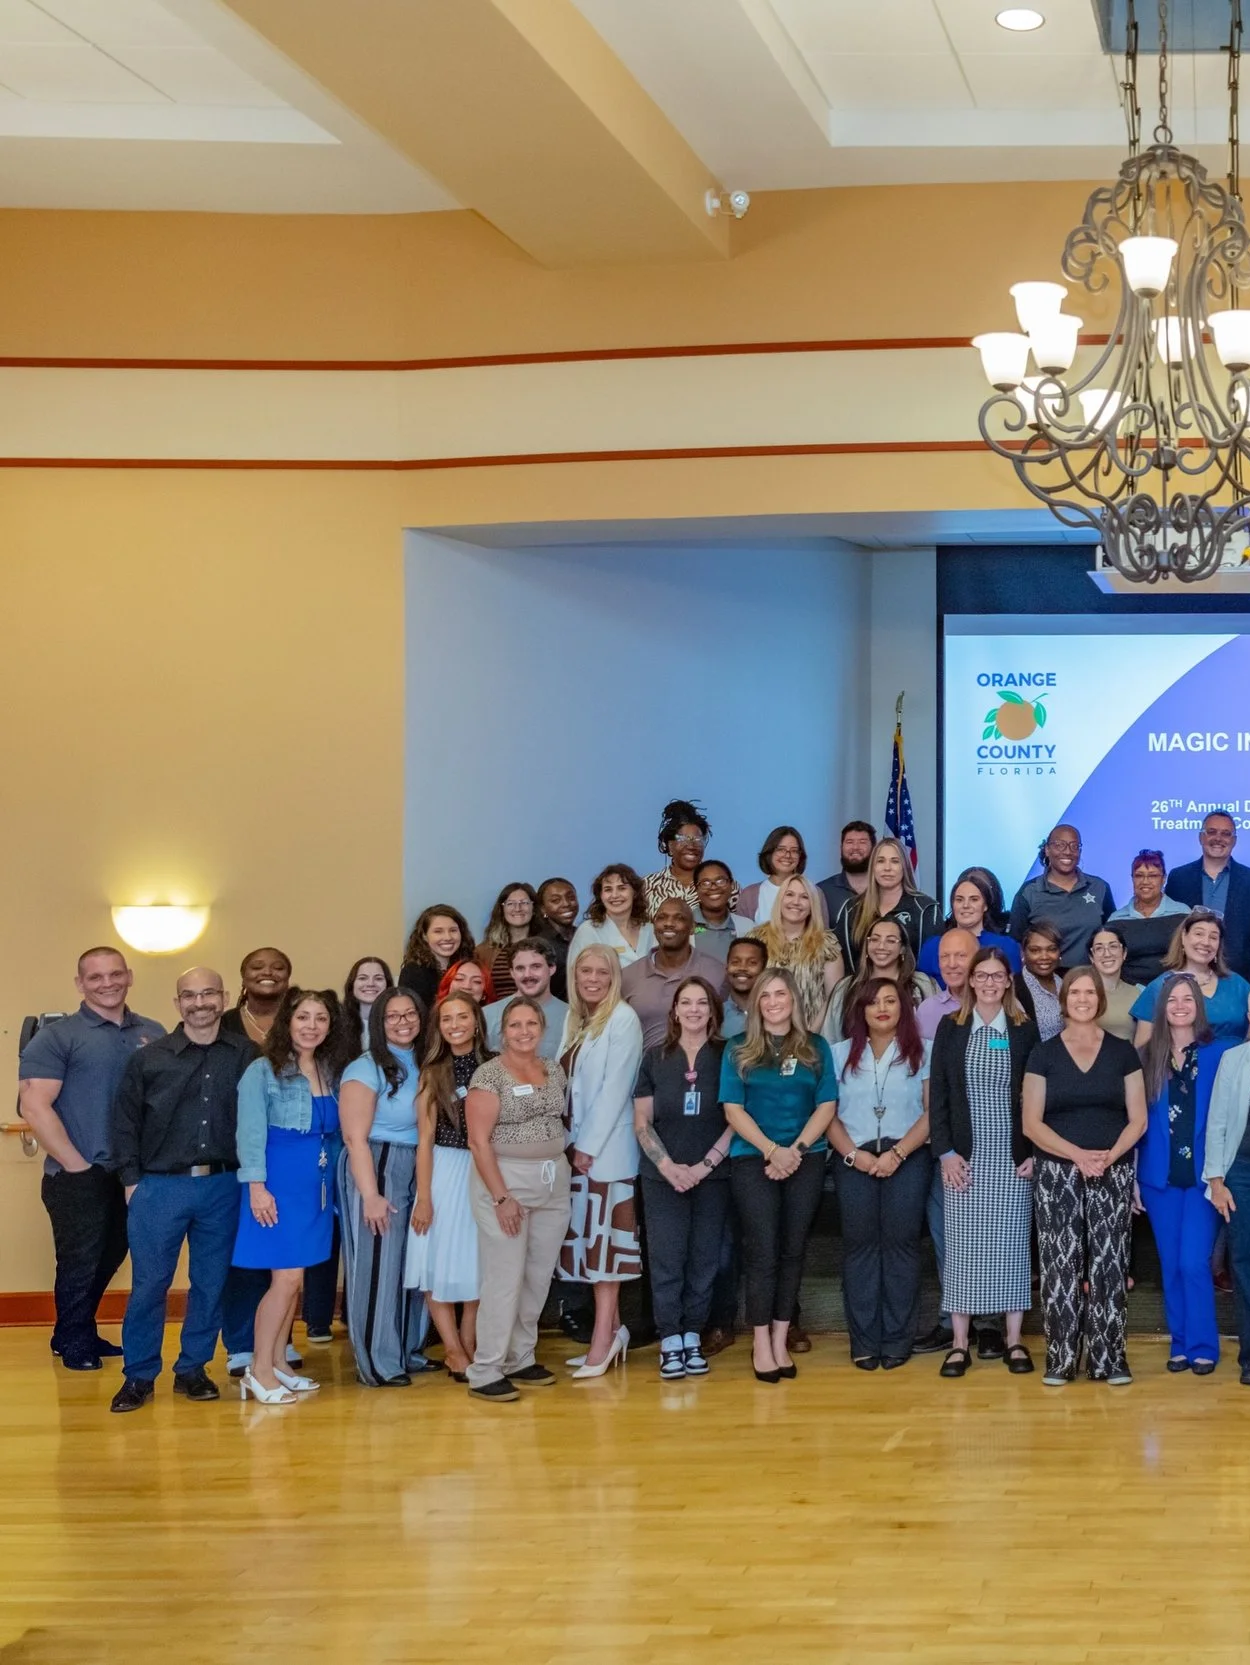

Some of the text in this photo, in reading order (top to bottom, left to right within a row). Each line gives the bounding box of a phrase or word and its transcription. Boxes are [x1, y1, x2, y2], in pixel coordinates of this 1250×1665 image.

[976, 672, 1057, 687] ORANGE
[1148, 732, 1229, 752] MAGIC
[976, 744, 1057, 759] COUNTY
[977, 767, 1057, 776] FLORIDA
[1151, 799, 1183, 813] 26TH
[1186, 800, 1240, 813] Annual
[1151, 817, 1202, 830] Treatm
